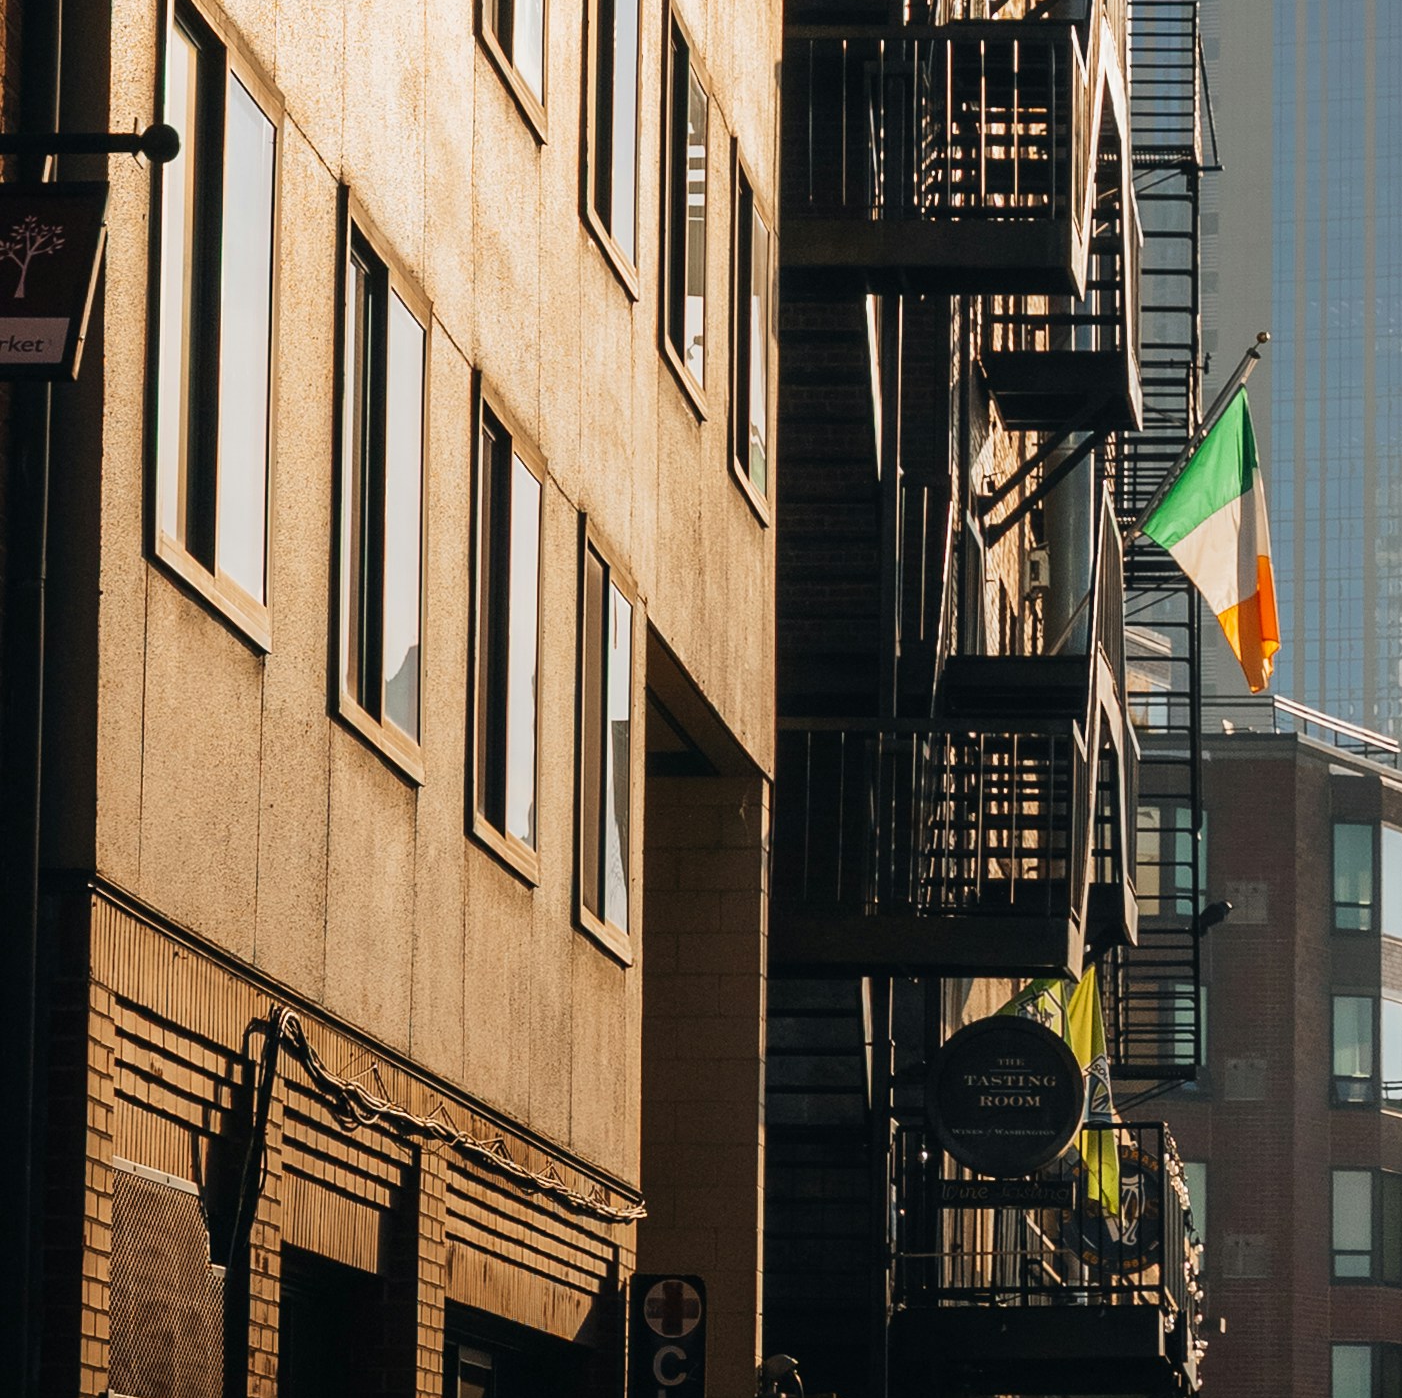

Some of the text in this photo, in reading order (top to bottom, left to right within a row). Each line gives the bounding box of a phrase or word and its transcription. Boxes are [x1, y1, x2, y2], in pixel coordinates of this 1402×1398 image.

[998, 1058, 1024, 1066] THE
[963, 1075, 1056, 1087] TASTING
[980, 1095, 1041, 1107] ROOM
